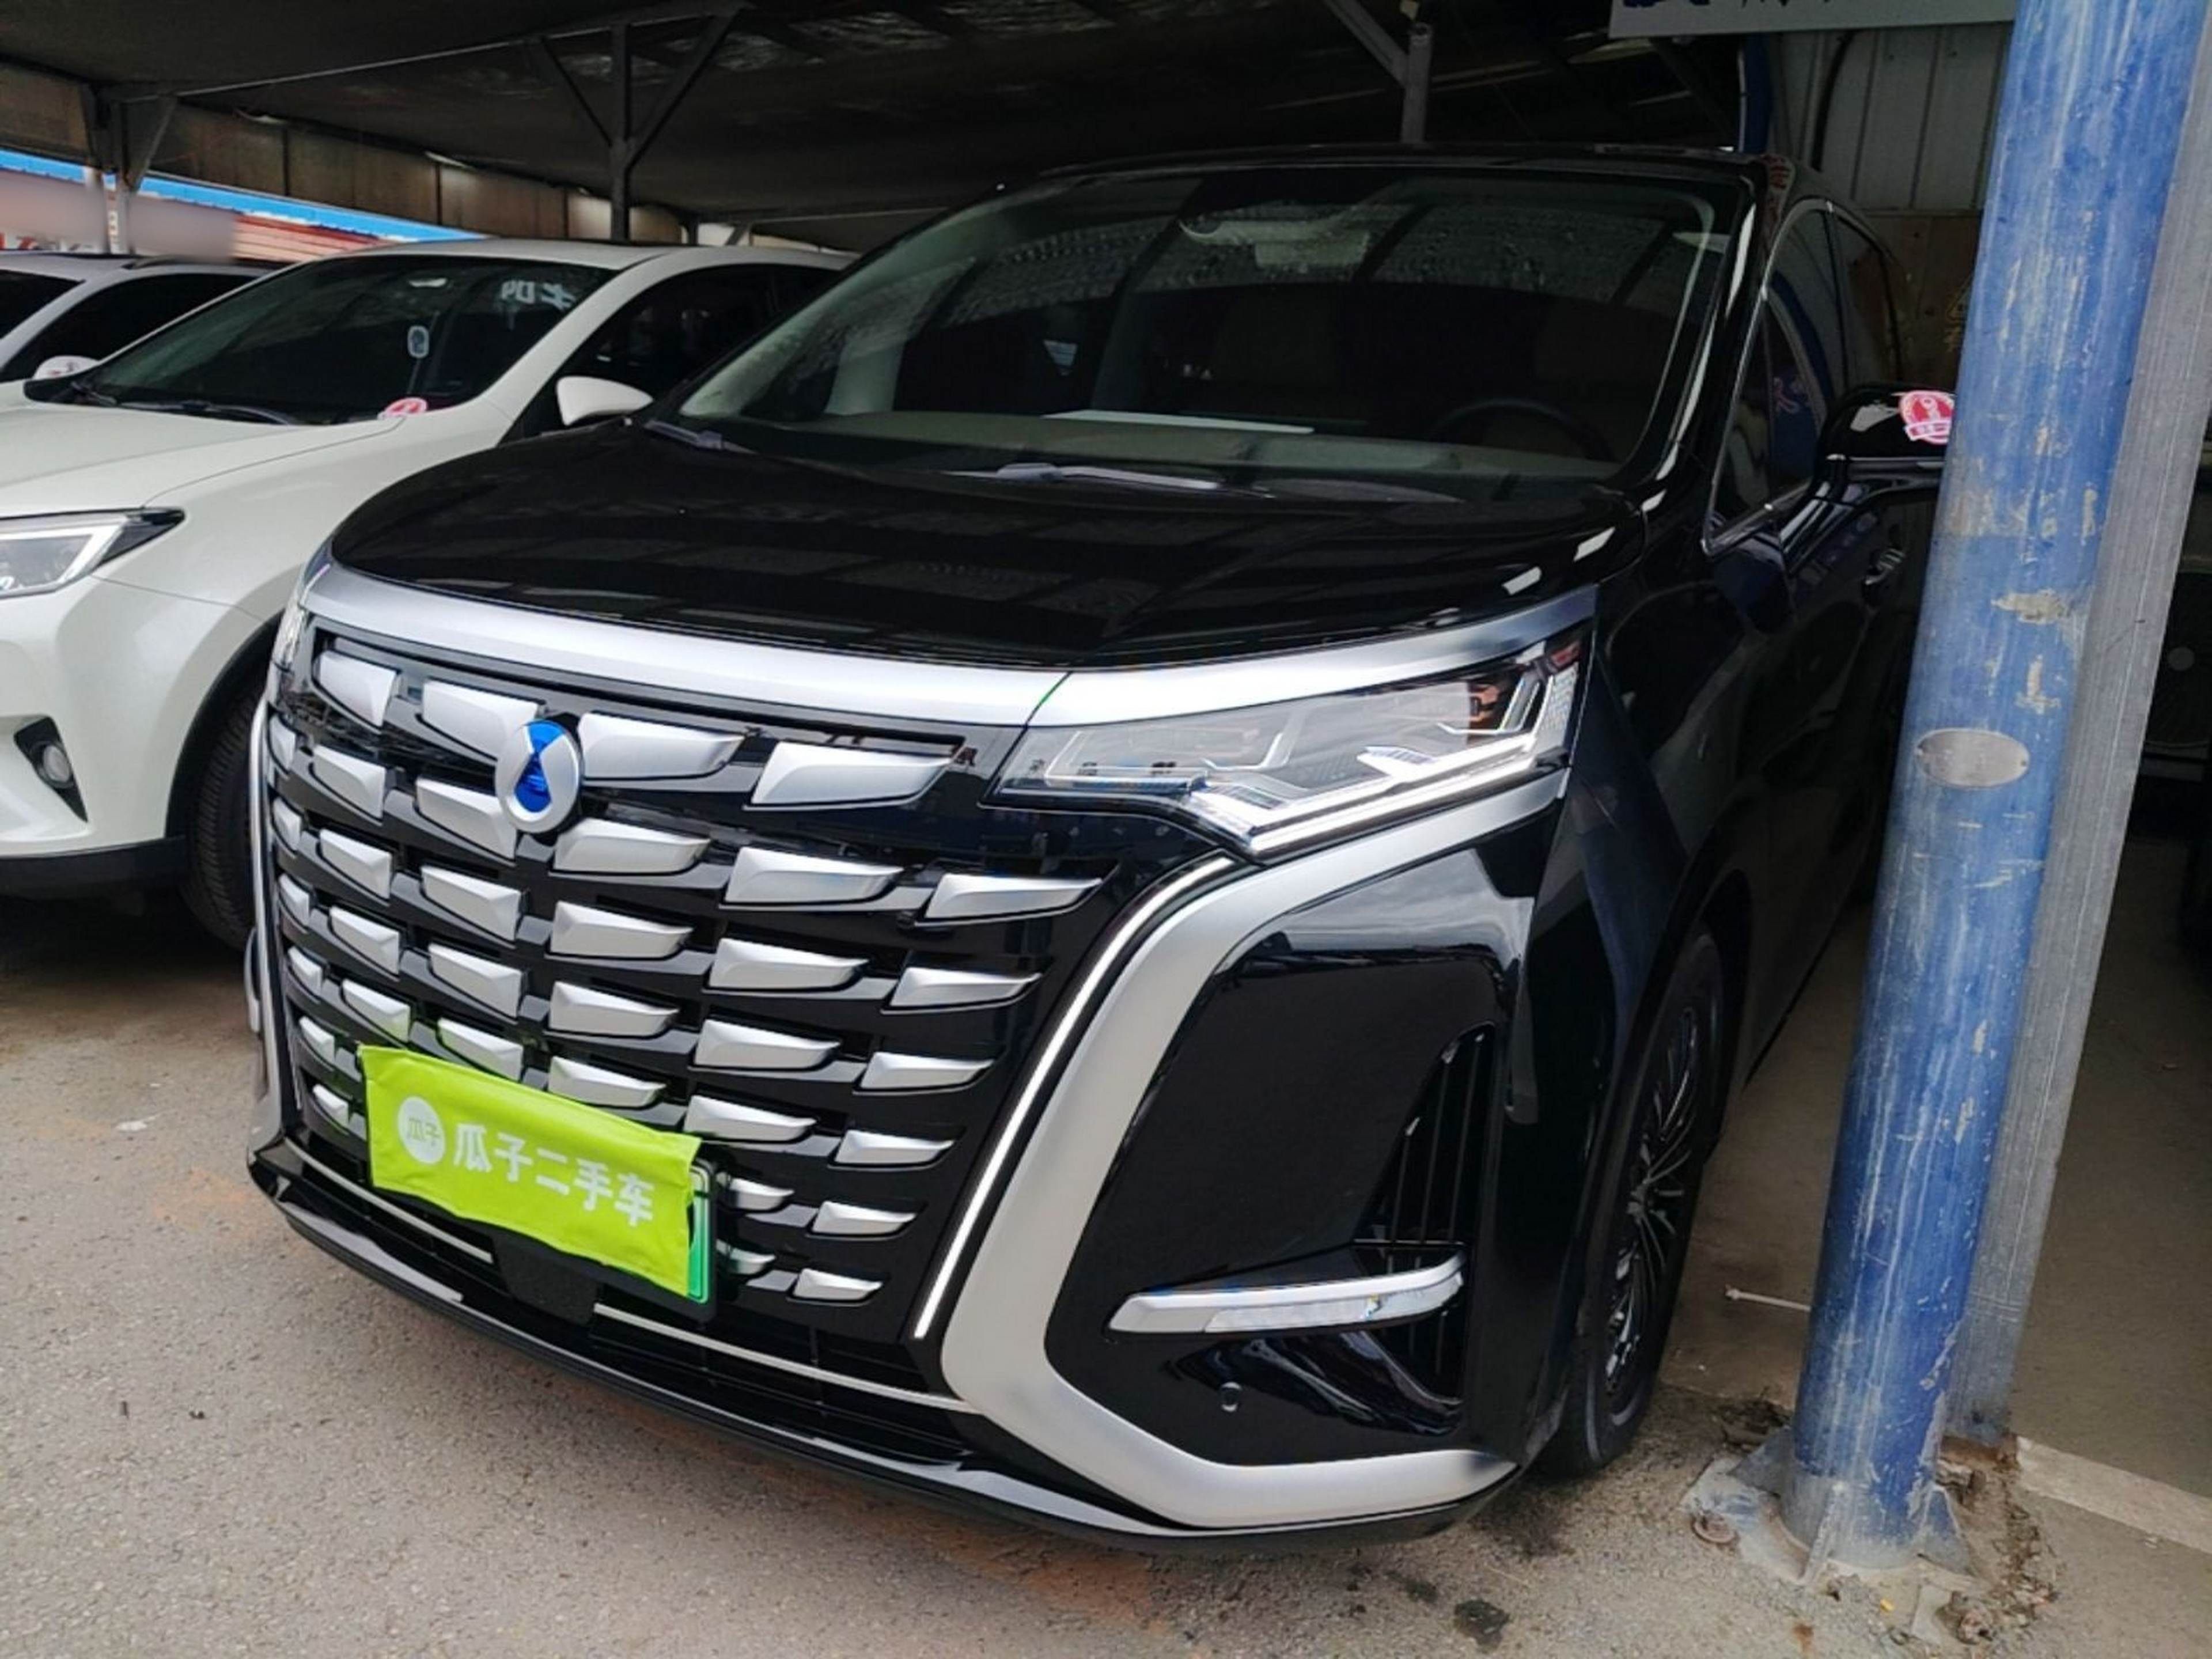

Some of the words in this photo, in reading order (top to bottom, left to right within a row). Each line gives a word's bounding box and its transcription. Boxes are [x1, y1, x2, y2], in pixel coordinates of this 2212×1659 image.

[406, 1116, 441, 1147] 瓜子
[453, 1123, 654, 1227] 瓜子二手车
